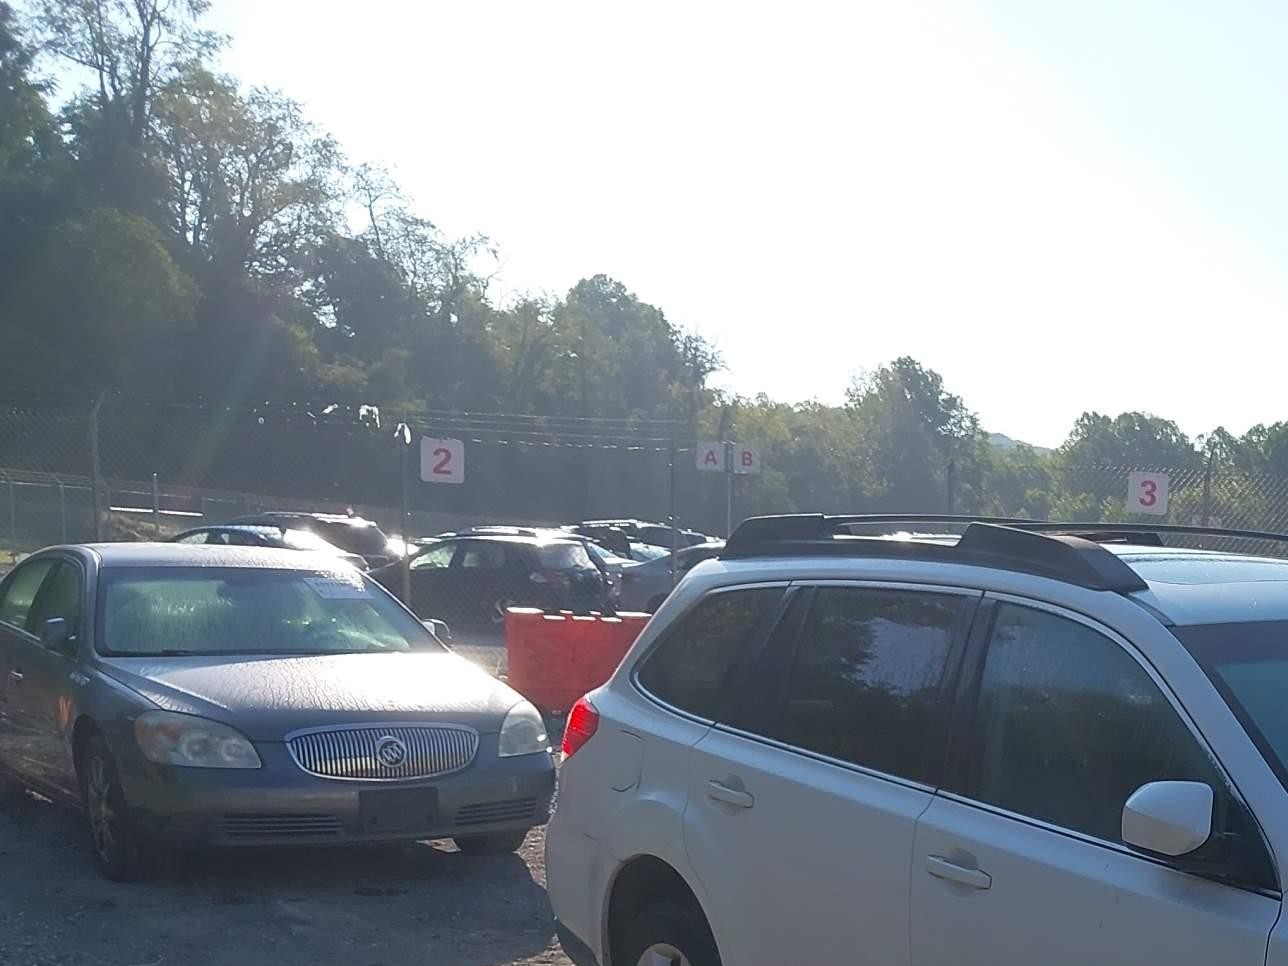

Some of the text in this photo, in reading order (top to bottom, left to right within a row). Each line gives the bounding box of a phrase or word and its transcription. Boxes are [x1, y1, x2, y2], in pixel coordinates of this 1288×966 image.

[432, 447, 453, 475] 2
[704, 450, 718, 465] A
[742, 451, 753, 466] B
[1139, 480, 1157, 507] 3
